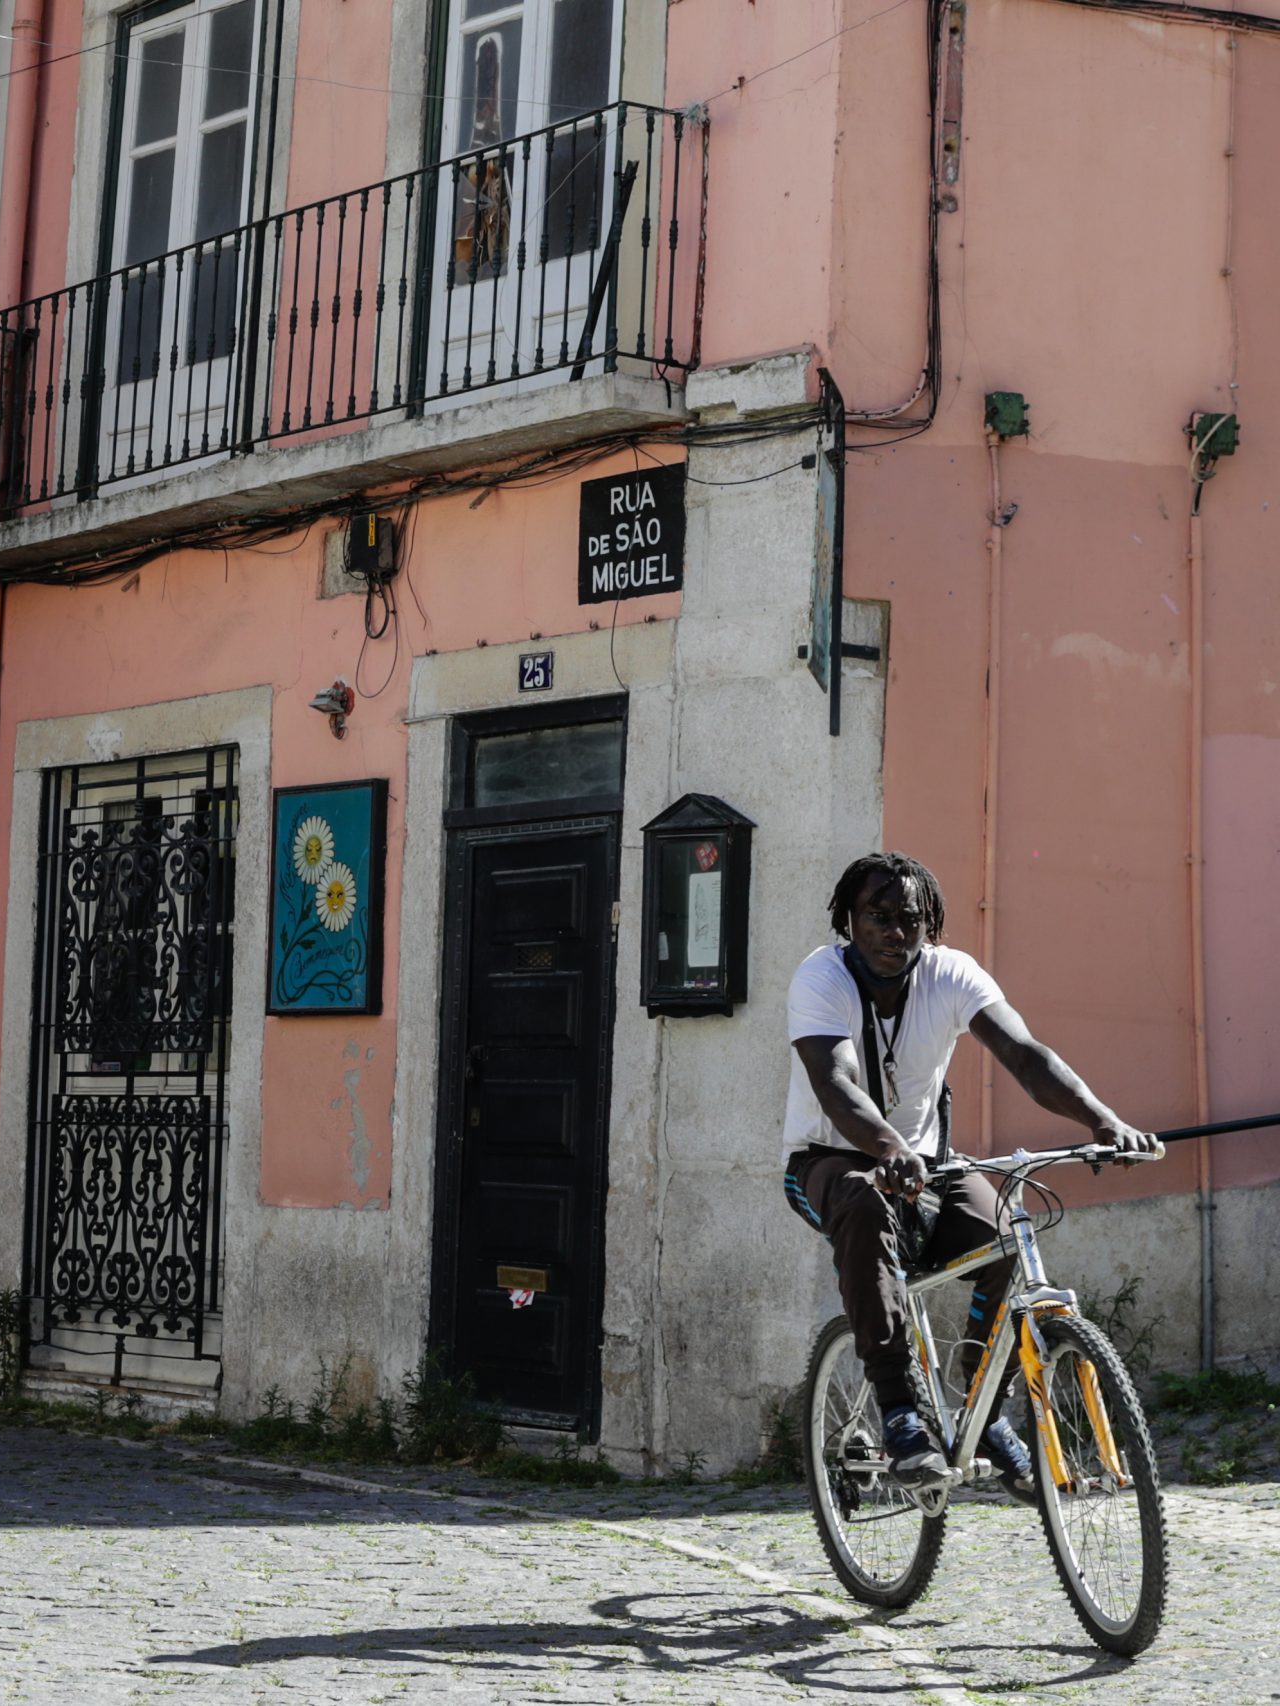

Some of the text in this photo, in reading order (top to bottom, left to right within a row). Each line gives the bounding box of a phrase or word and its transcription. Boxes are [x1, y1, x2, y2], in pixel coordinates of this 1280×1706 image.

[610, 481, 656, 515] RUA
[588, 534, 611, 557] DE
[592, 553, 675, 594] MIGUEL
[523, 657, 545, 689] 25
